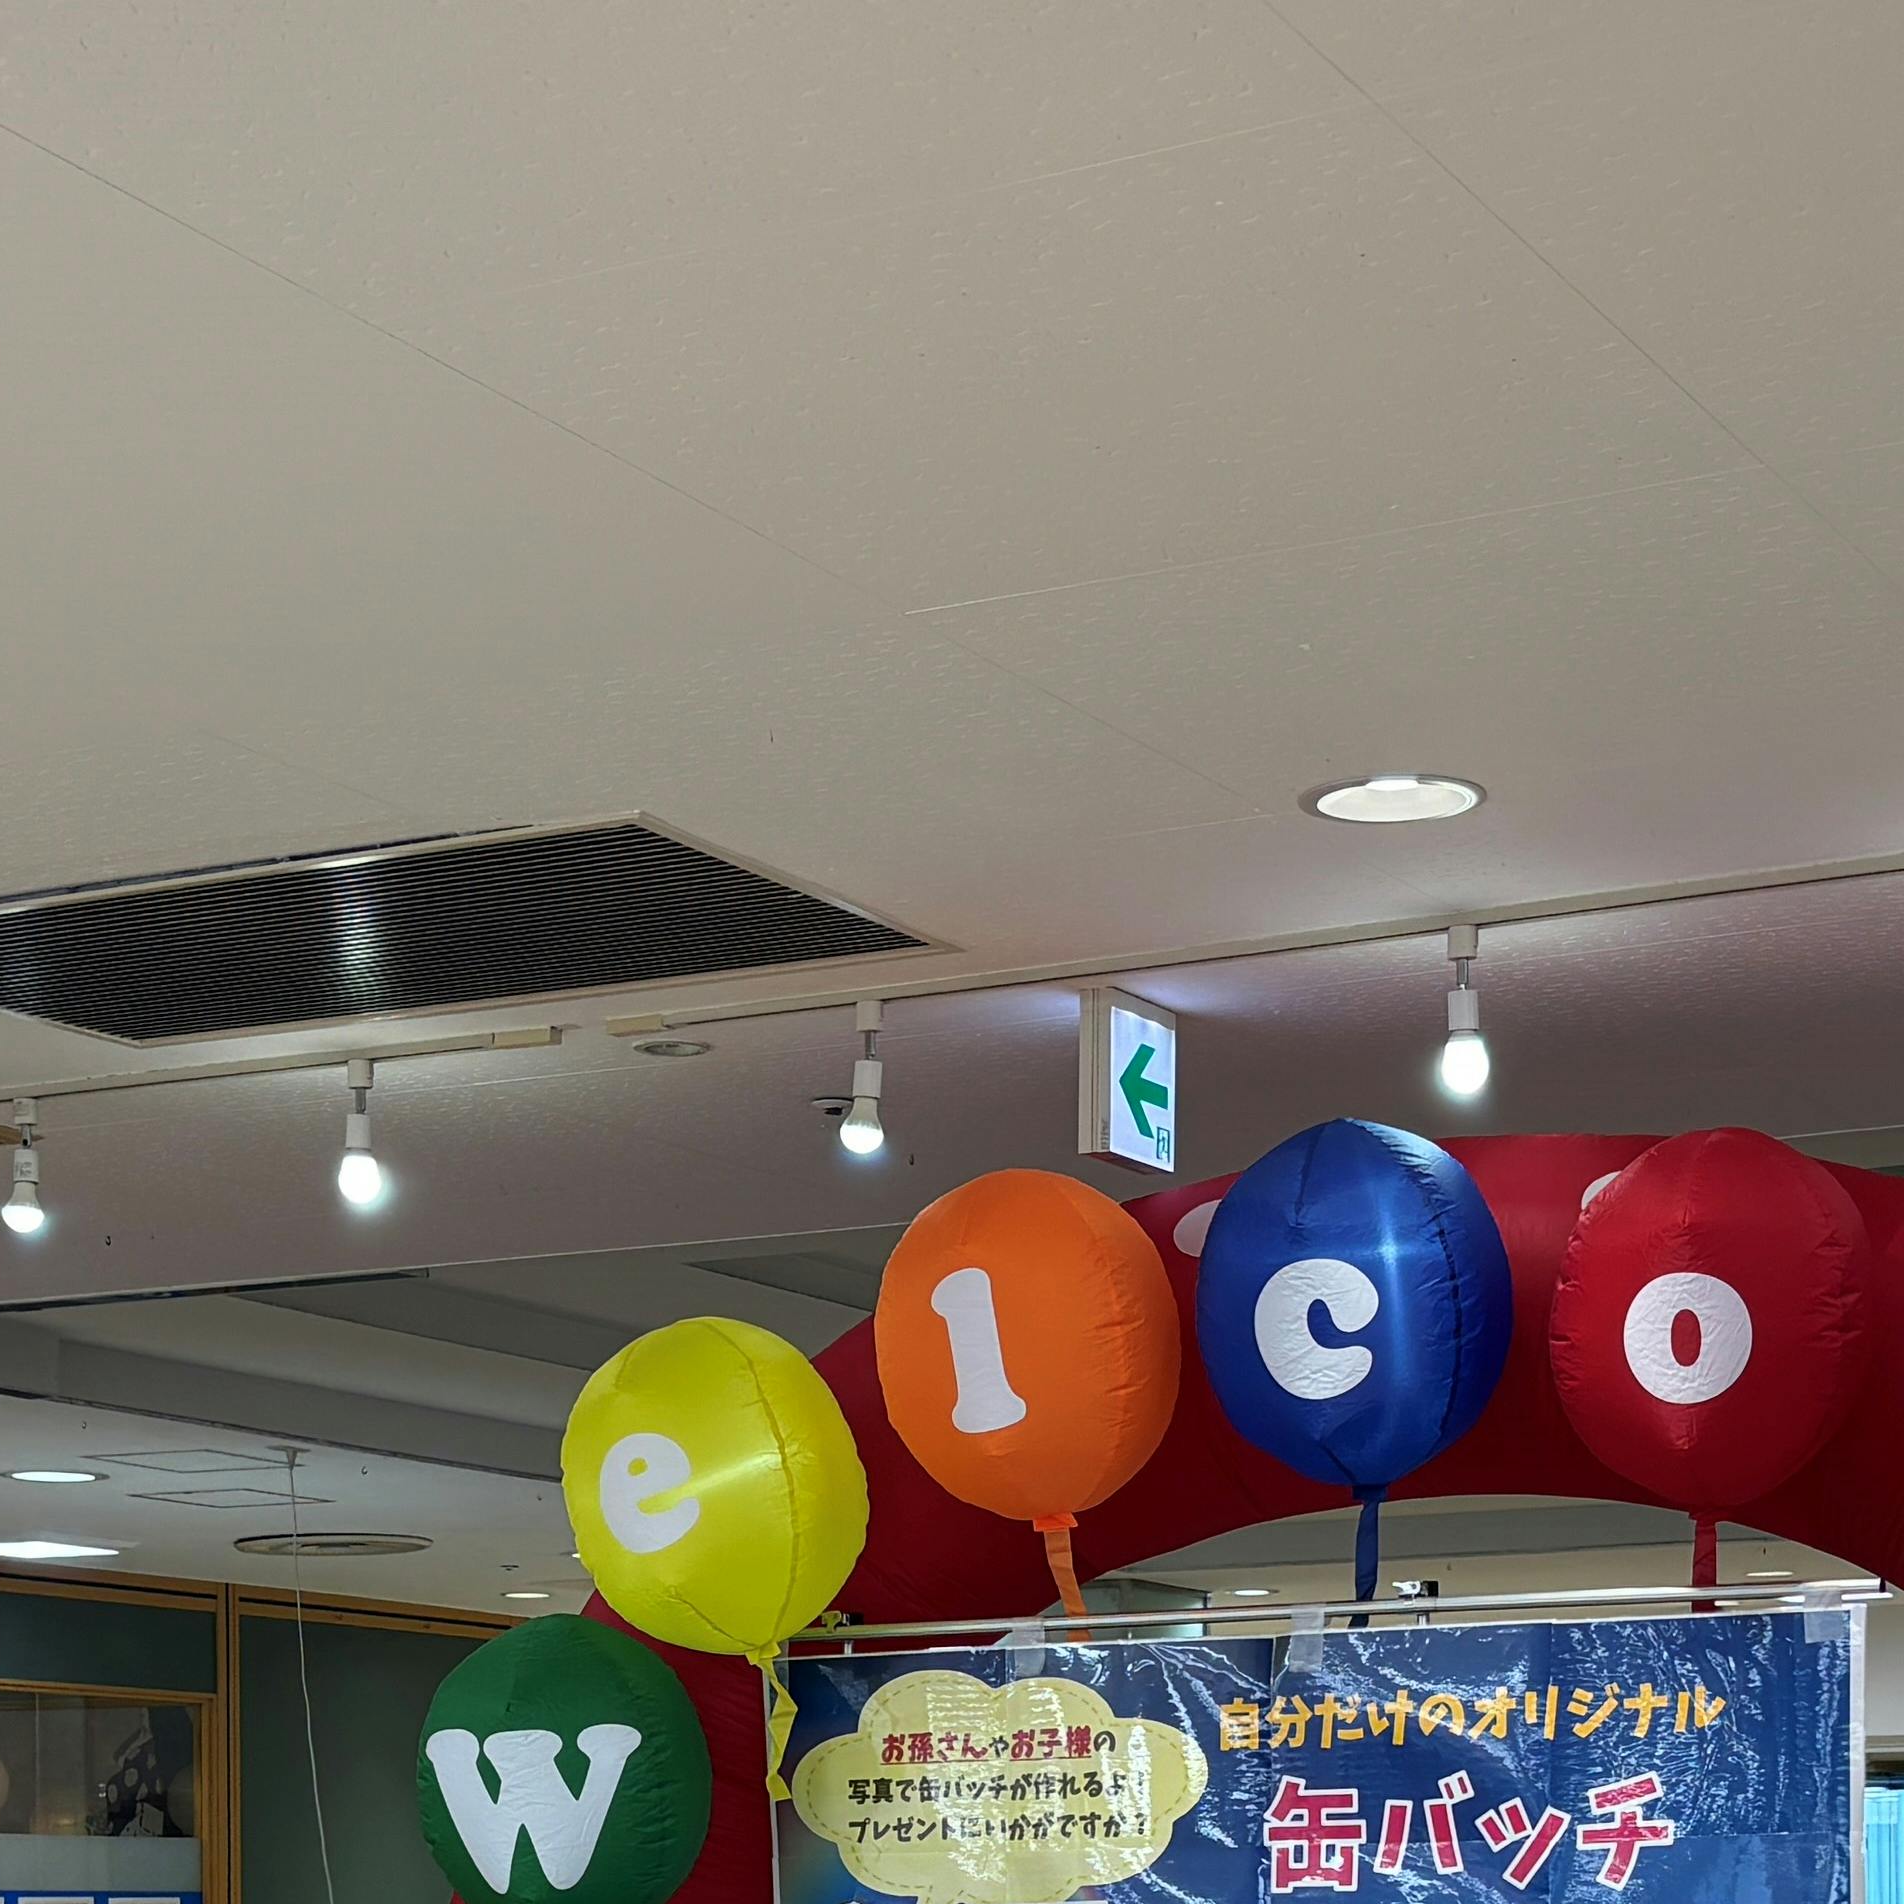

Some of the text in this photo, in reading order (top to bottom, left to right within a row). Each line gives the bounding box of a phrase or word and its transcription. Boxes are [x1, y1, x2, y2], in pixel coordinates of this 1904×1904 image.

[881, 1725, 1117, 1763] お孫さんやお子様の
[1218, 1683, 1726, 1750] 自分だけのオリジナル
[1263, 1769, 1675, 1892] 缶バッチ
